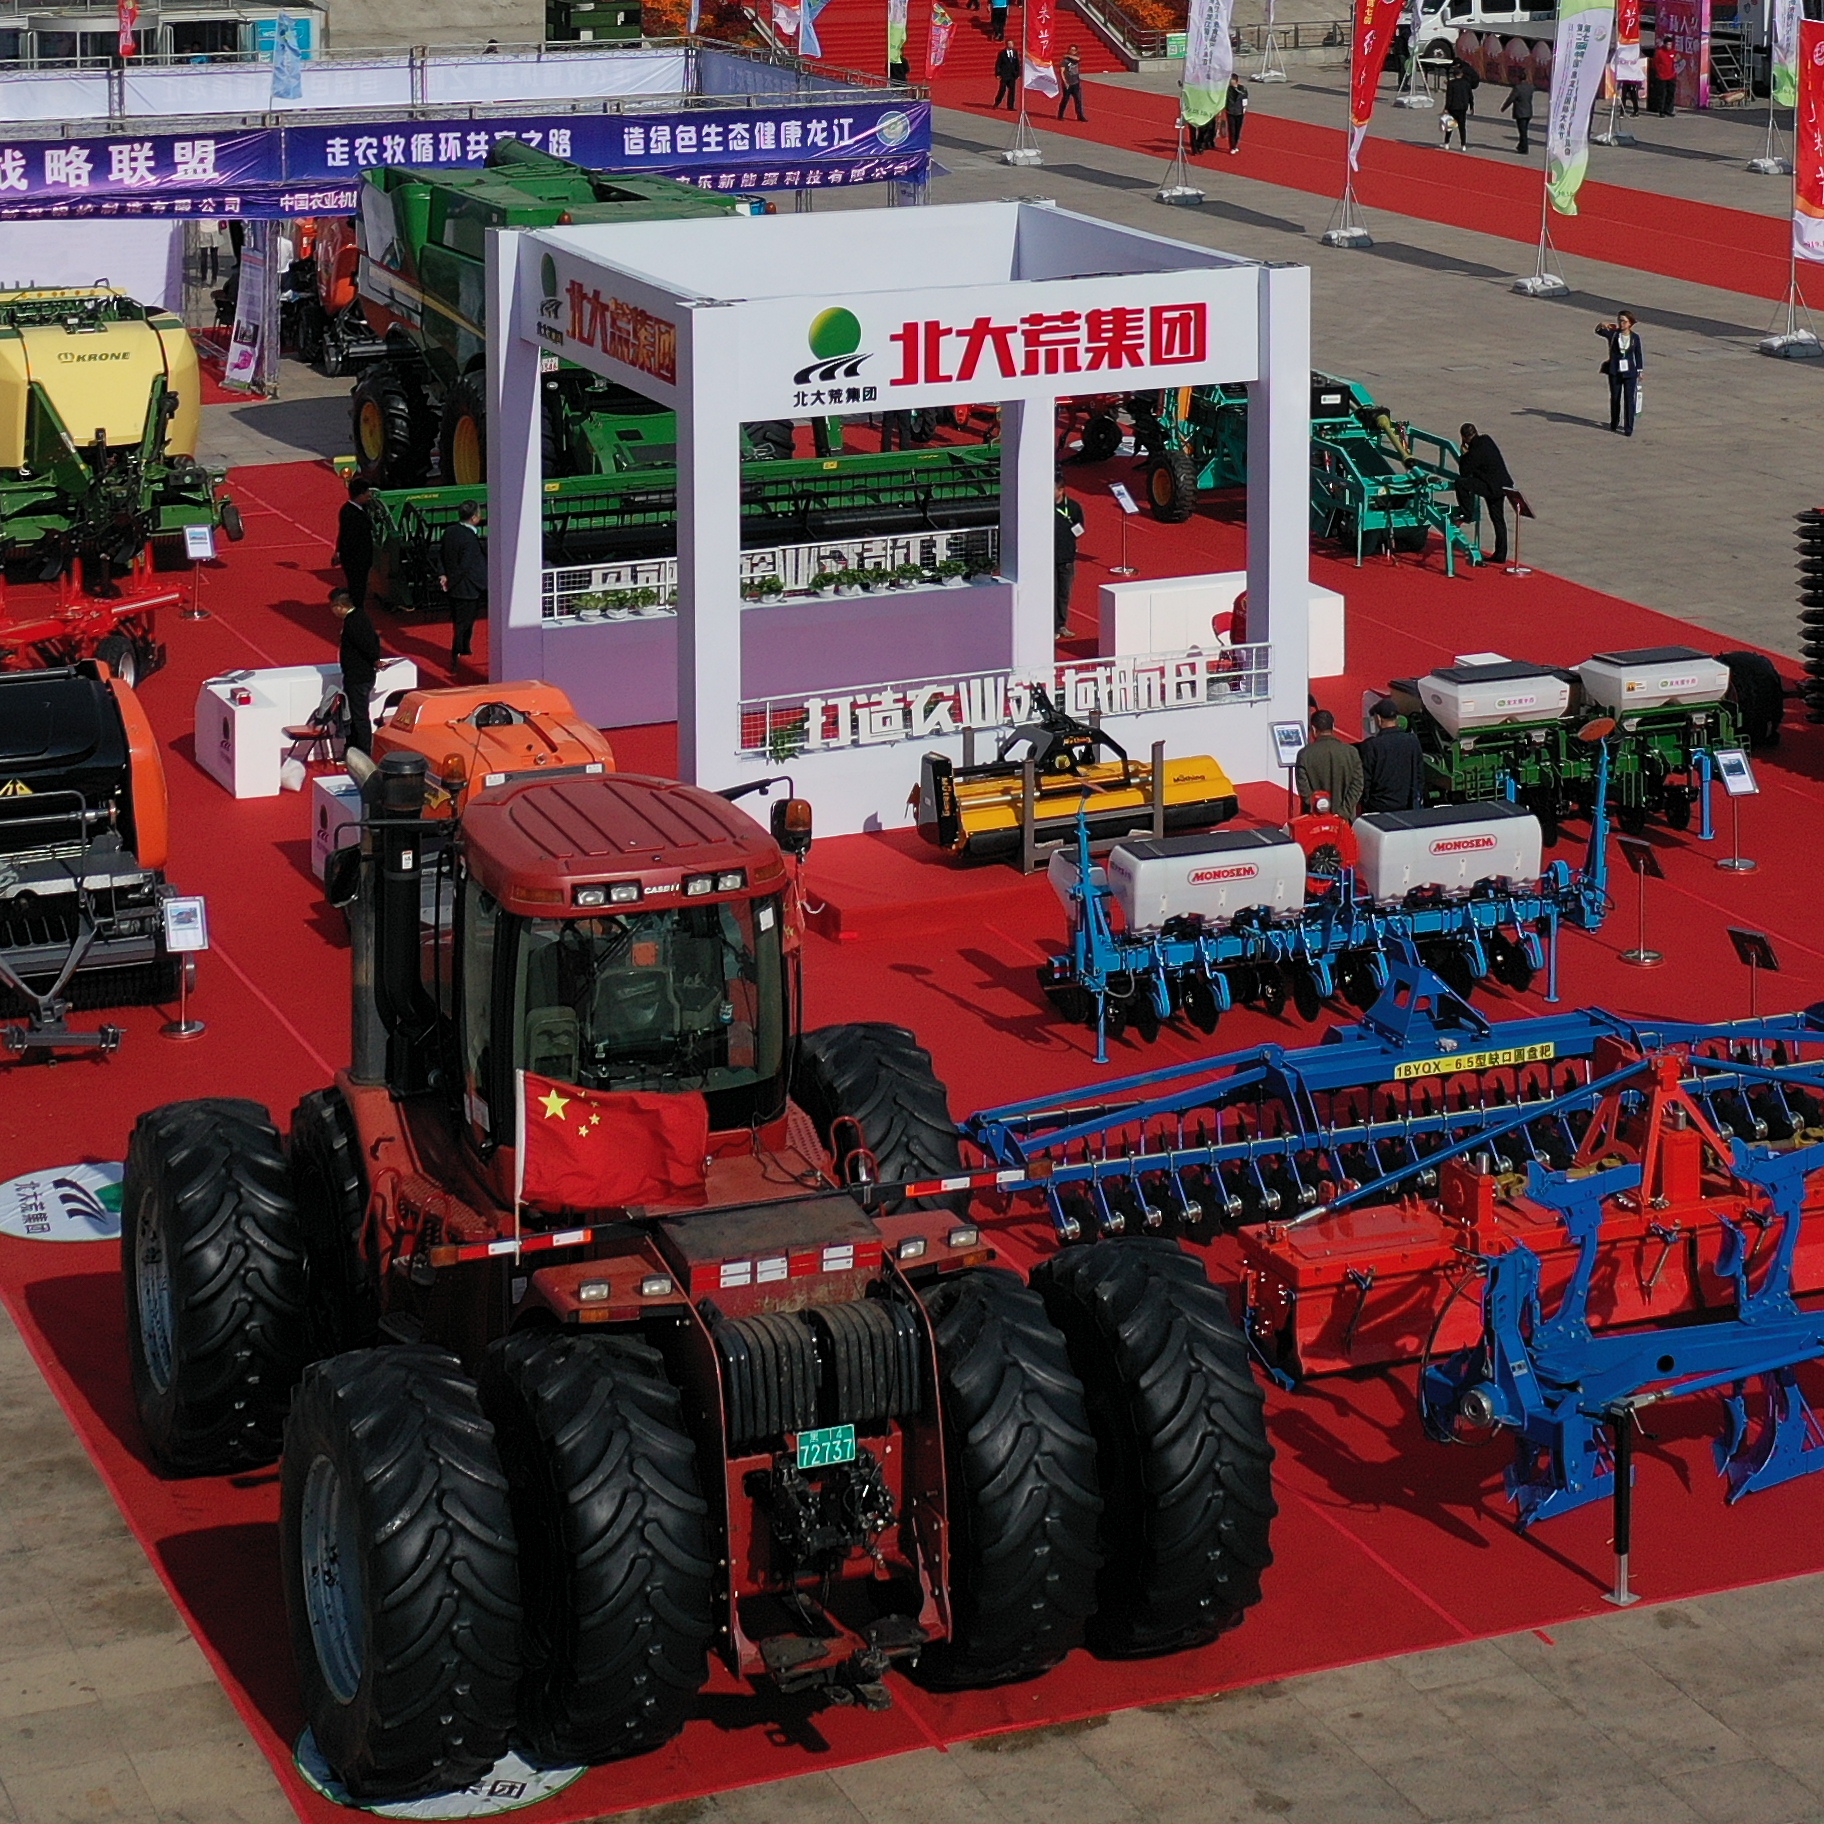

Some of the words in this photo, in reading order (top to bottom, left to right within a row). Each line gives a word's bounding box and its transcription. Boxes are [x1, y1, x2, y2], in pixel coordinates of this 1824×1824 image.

[622, 117, 855, 155] 造绿色生态健康龙江
[564, 278, 677, 387] 北大荒集团
[888, 301, 1208, 388] 北大荒集团
[75, 351, 131, 364] KRONE
[792, 385, 878, 407] 北大荒集团
[1433, 837, 1494, 853] MONOSEM
[1194, 866, 1254, 883] MONOSEM
[800, 1438, 852, 1466] 72737
